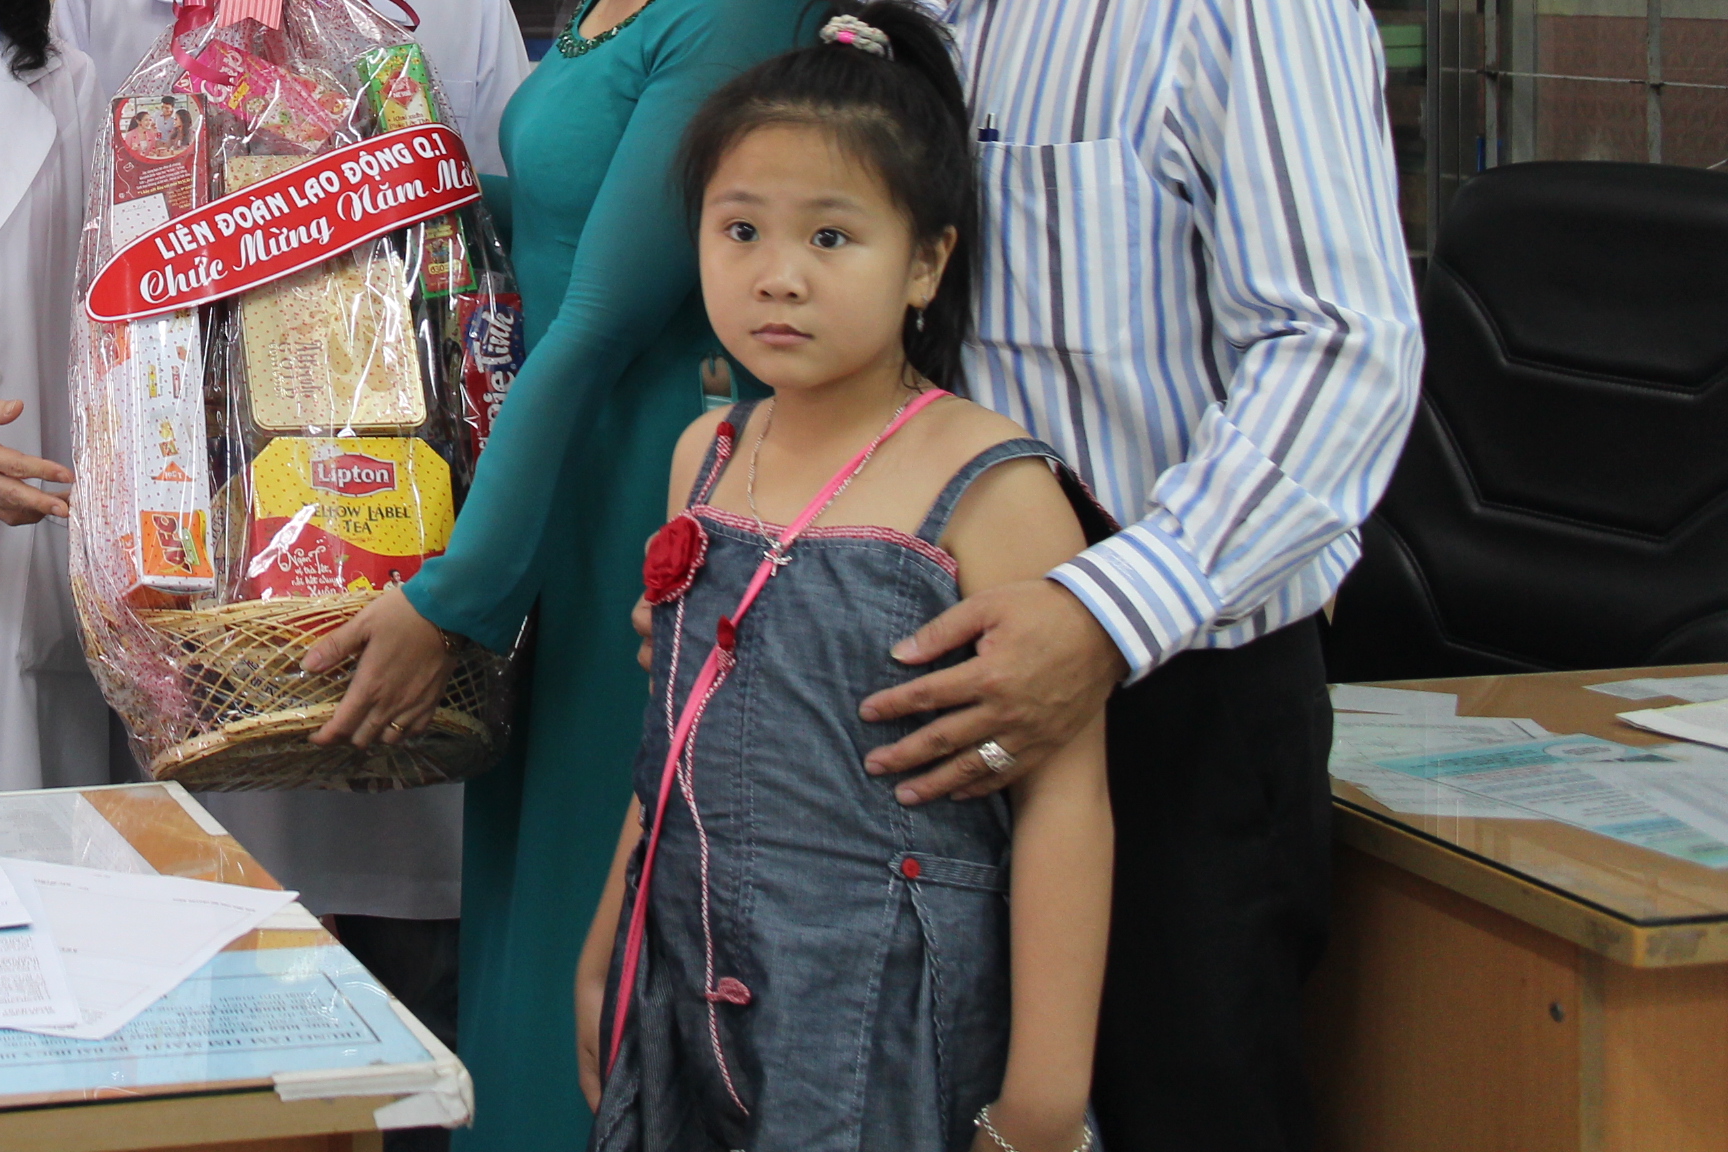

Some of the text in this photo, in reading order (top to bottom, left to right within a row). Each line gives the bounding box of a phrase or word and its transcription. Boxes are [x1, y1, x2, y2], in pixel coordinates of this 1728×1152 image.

[154, 133, 447, 260] LIÊN ĐOÀN LAO ĐỘNG Q.1
[140, 256, 228, 304] Chúc
[231, 215, 335, 272] Mừng
[336, 178, 430, 222] Năm
[318, 462, 390, 488] Lipton
[343, 520, 372, 534] TEA
[368, 505, 411, 522] LABEL
[152, 513, 193, 575] AFC
